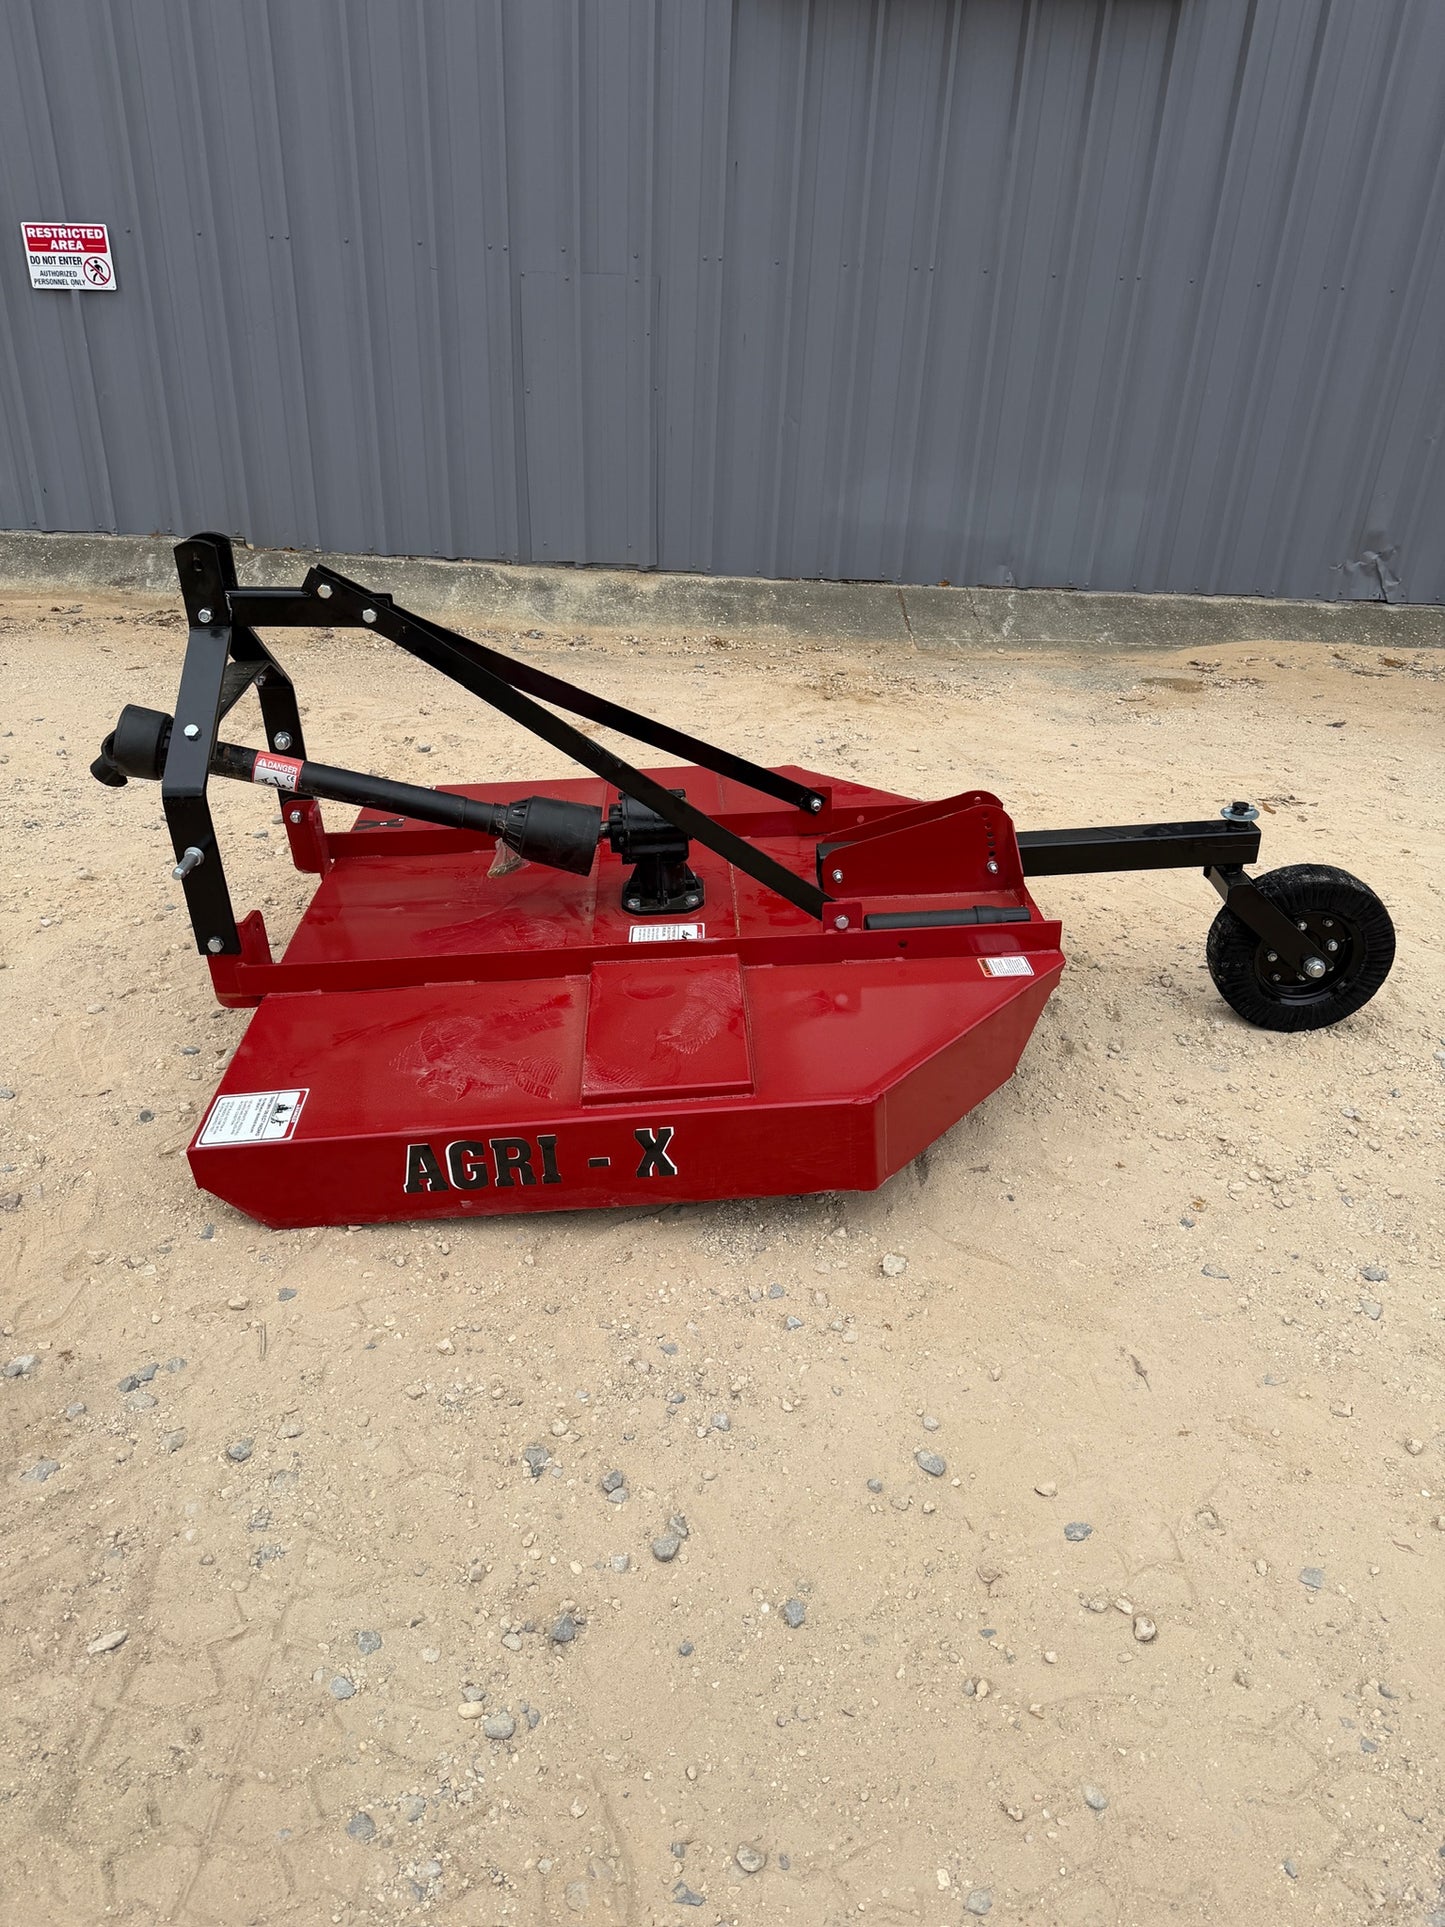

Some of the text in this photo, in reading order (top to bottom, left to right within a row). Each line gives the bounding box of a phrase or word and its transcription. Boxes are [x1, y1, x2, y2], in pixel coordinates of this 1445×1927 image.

[26, 227, 104, 239] RESTRICTED
[50, 239, 85, 250] AREA
[30, 255, 83, 265] DO NOT ENTER
[34, 278, 69, 286] PERSONNEL
[267, 761, 298, 774] DANGER
[403, 1134, 562, 1194] AGRI
[633, 1126, 678, 1178] X
